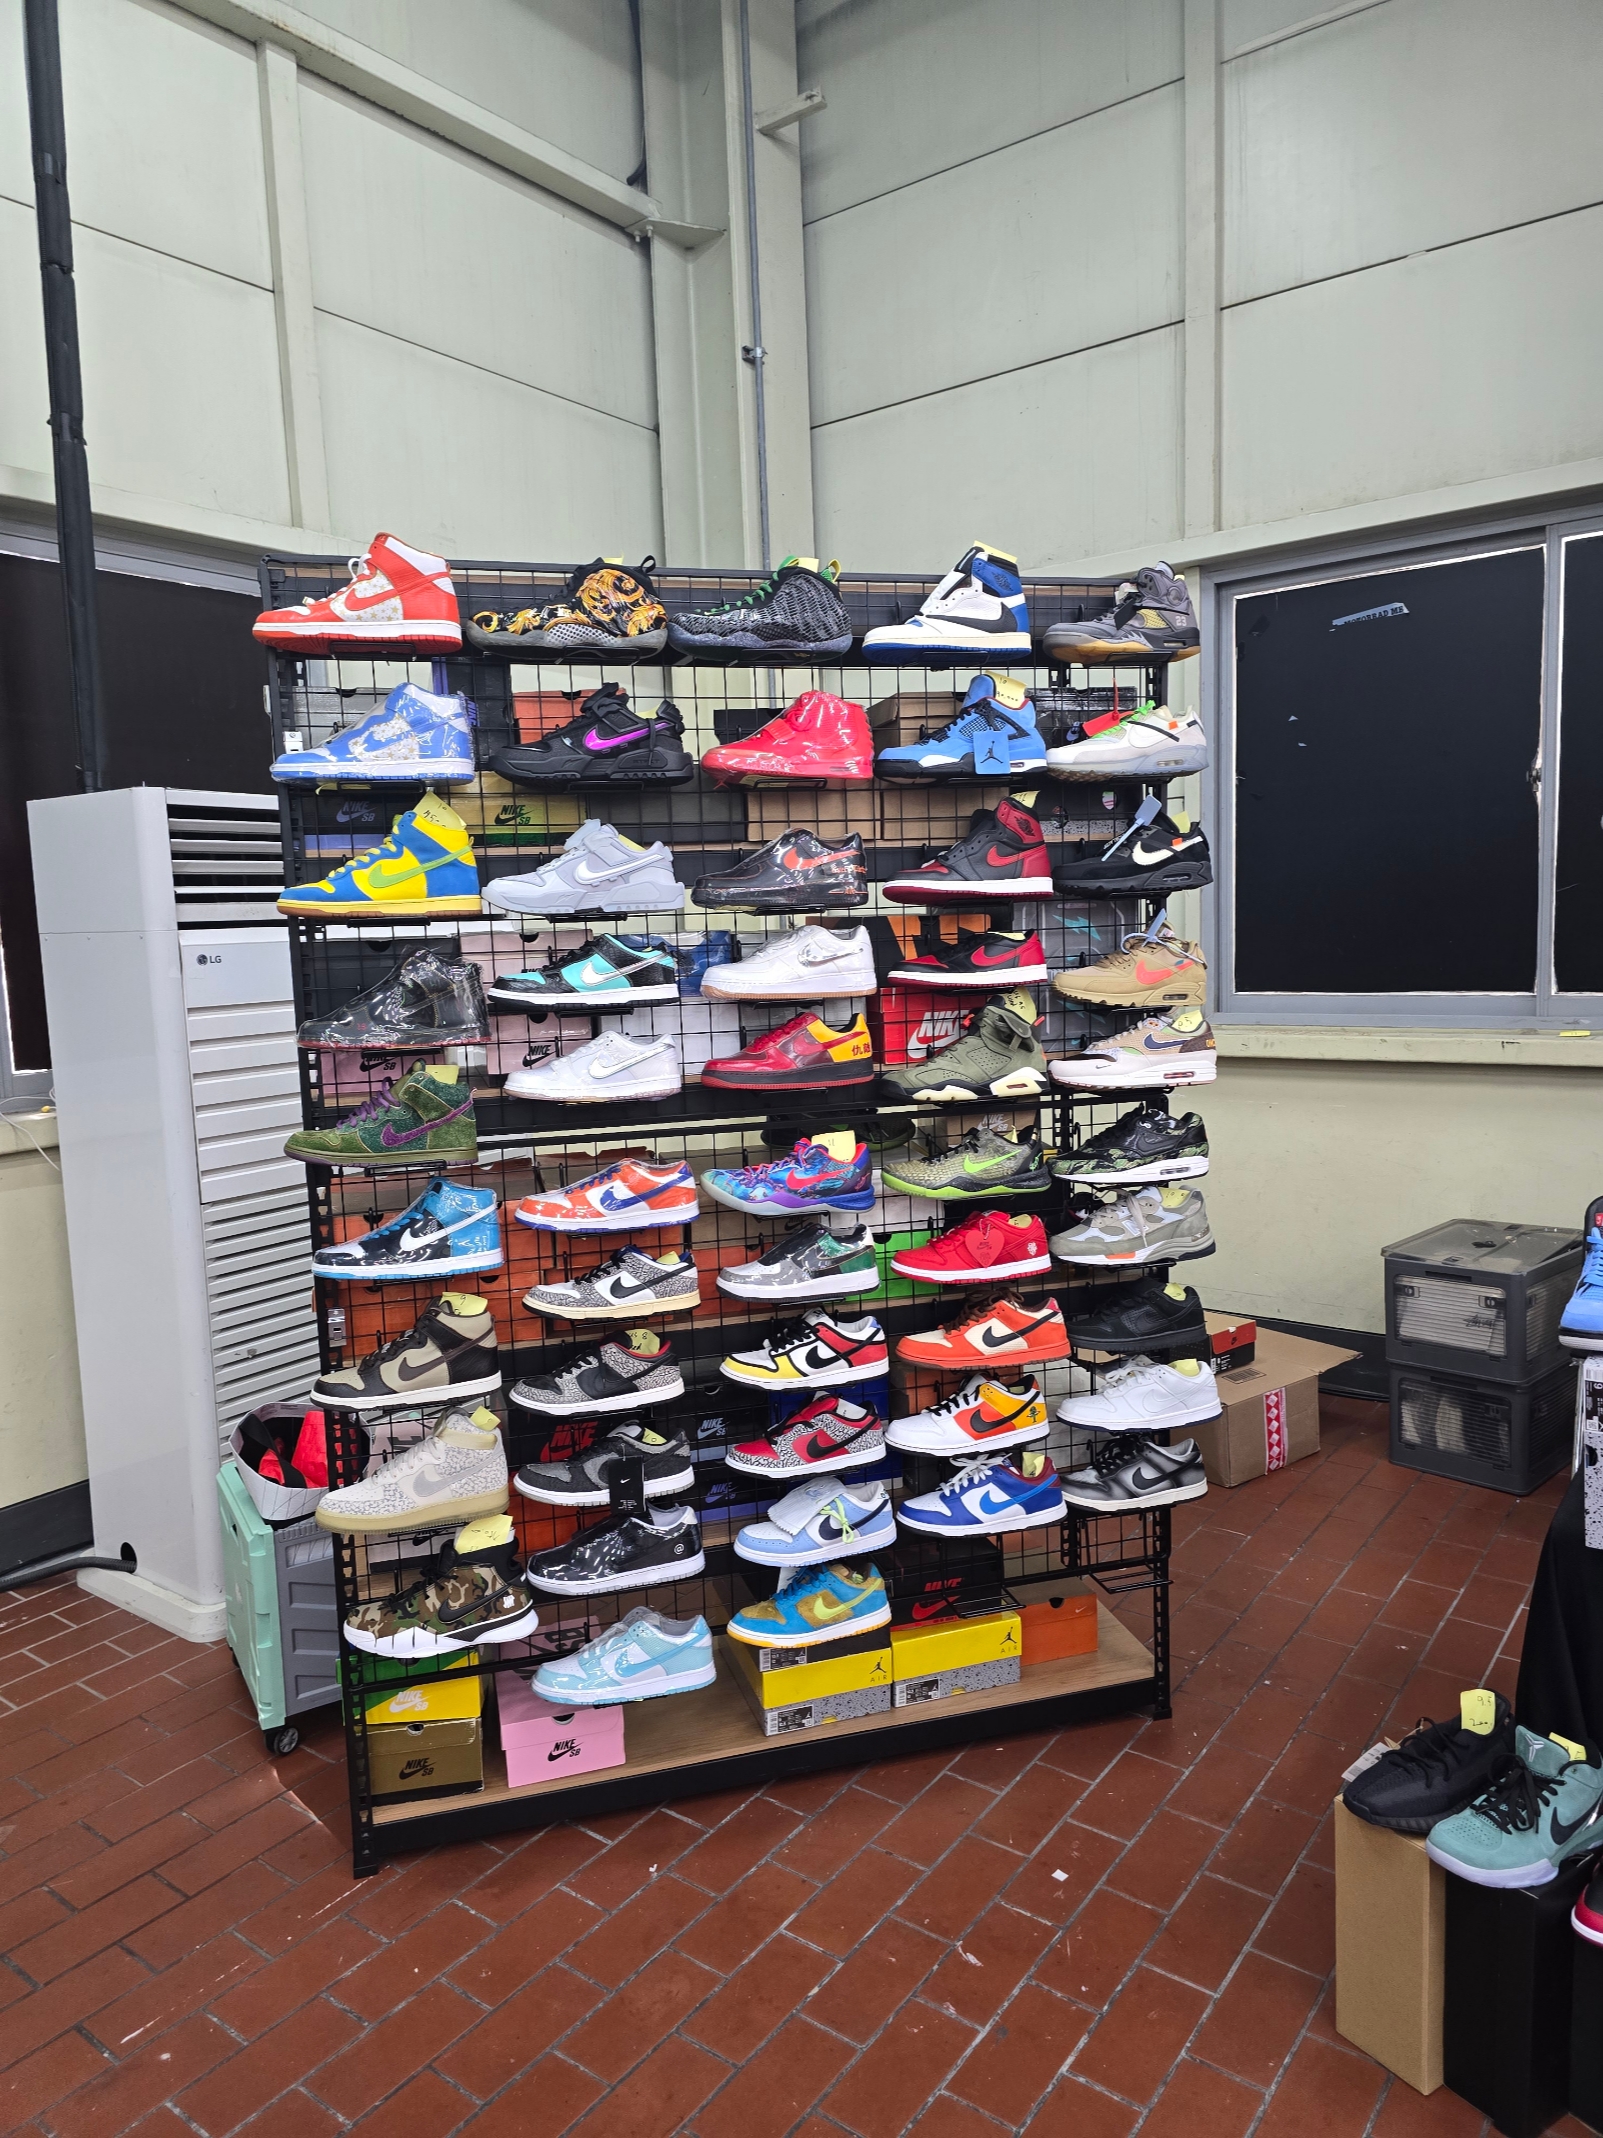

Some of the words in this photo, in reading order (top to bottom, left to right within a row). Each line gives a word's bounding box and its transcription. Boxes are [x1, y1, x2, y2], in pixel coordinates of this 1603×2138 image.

[1175, 615, 1187, 627] 23
[342, 801, 370, 813] NIKE
[500, 804, 526, 816] NIKE
[361, 813, 375, 822] SB
[518, 816, 531, 825] SB
[209, 955, 222, 964] LG
[918, 1009, 970, 1038] NIKE
[529, 1044, 552, 1056] NIKE
[383, 1061, 397, 1071] SB
[982, 1113, 1005, 1125] NIKE
[997, 1123, 1009, 1132] SB
[701, 1417, 724, 1430] NIKE
[710, 1481, 733, 1494] NIKE
[1000, 1645, 1018, 1654] AIR
[870, 1674, 887, 1683] AIR
[396, 1690, 424, 1703] NIKE
[414, 1701, 429, 1711] SB
[553, 1738, 577, 1752] NIKE
[569, 1748, 581, 1758] SB
[404, 1757, 430, 1771] NIKE
[421, 1767, 434, 1777] SB
